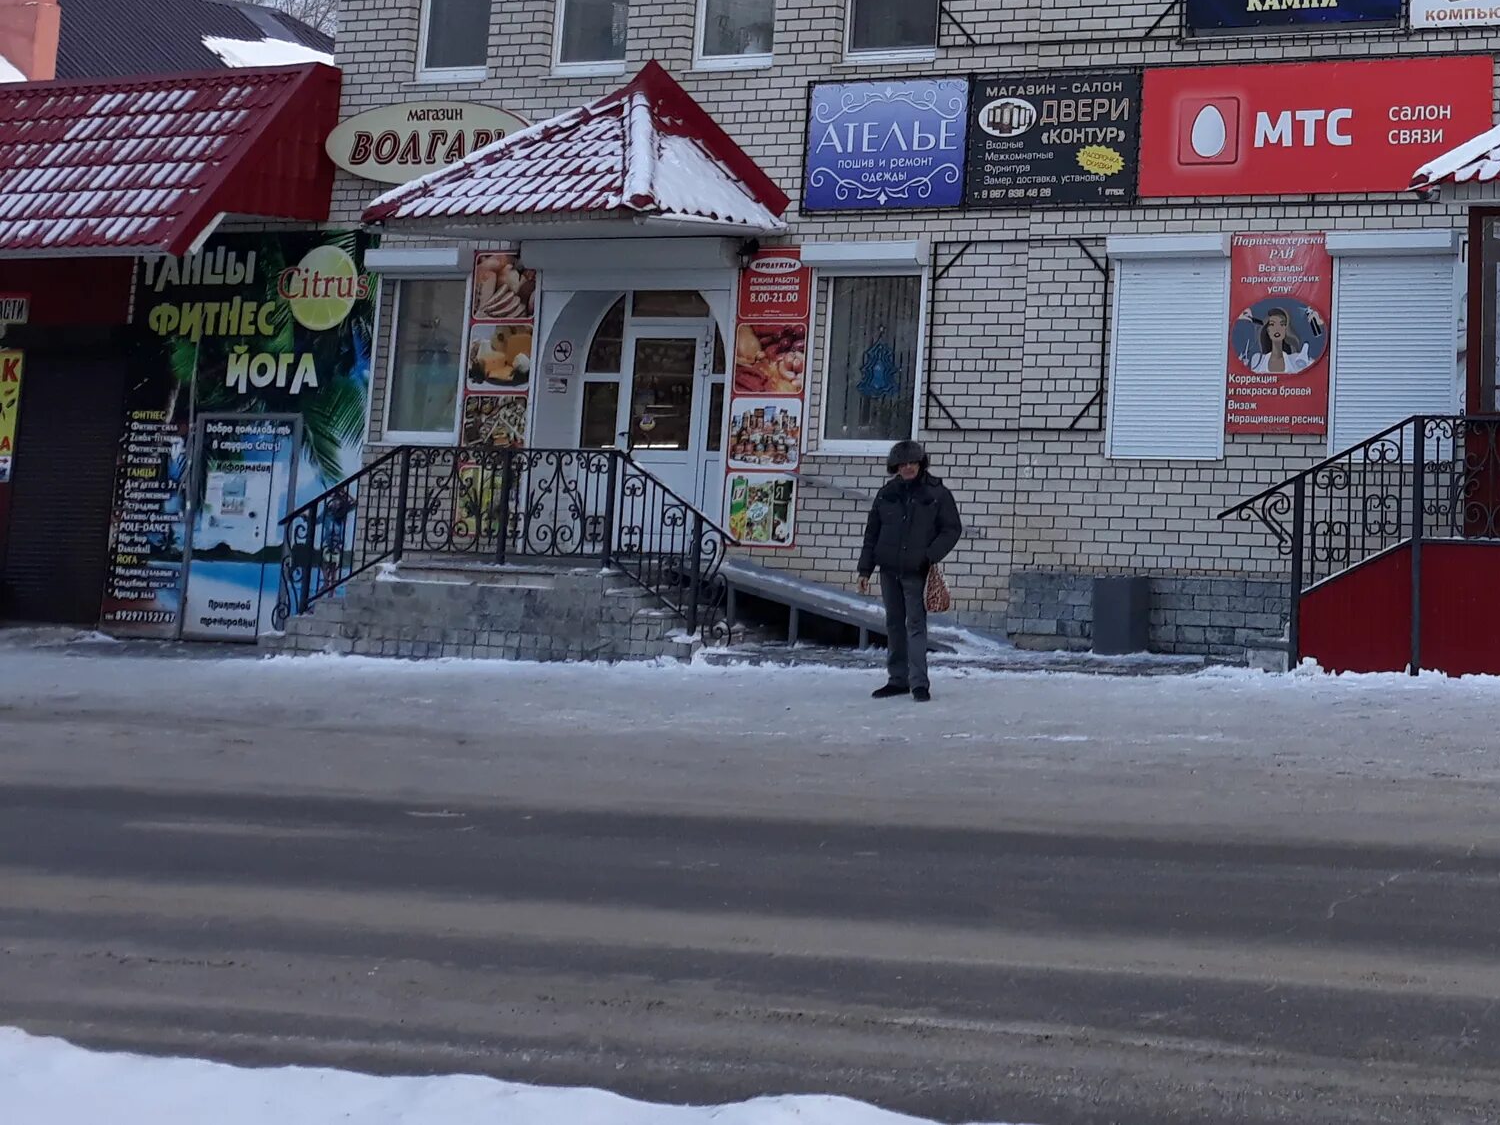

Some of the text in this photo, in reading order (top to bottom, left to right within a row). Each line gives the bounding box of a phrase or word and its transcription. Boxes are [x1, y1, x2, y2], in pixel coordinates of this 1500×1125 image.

[986, 82, 1122, 96] МАГАЗИН САЛОН
[407, 108, 463, 122] магазин
[1040, 98, 1129, 125] ДВЕРИ
[1389, 105, 1451, 121] салон
[1254, 109, 1352, 147] МТС
[816, 120, 959, 153] АТЕЛЬЕ
[1041, 127, 1126, 144] «КОНТУР»
[1388, 129, 1443, 144] связи
[349, 130, 505, 165] ВОЛГАР
[986, 141, 1023, 149] Входные
[837, 156, 933, 169] пошив и ремонт
[985, 152, 1054, 161] Межкомнатные
[984, 164, 1030, 173] Фурнитура
[861, 171, 906, 183] одежды
[1269, 248, 1295, 259] РАЙ
[144, 246, 256, 292] ТАНЦЫ
[1259, 264, 1275, 272] Все
[278, 267, 369, 300] Citrus
[1241, 275, 1319, 284] парикмахерских
[1268, 286, 1292, 294] услуг
[751, 293, 797, 302] 8.00-21.00
[150, 296, 276, 343] ФИТНЕС
[226, 345, 318, 395] ЙОГА
[1229, 374, 1277, 384] Коррекция
[1236, 387, 1277, 396] покраска
[1280, 386, 1311, 397] бровей
[1228, 400, 1257, 409] Визаж
[1228, 414, 1324, 425] Наращивание ресниц
